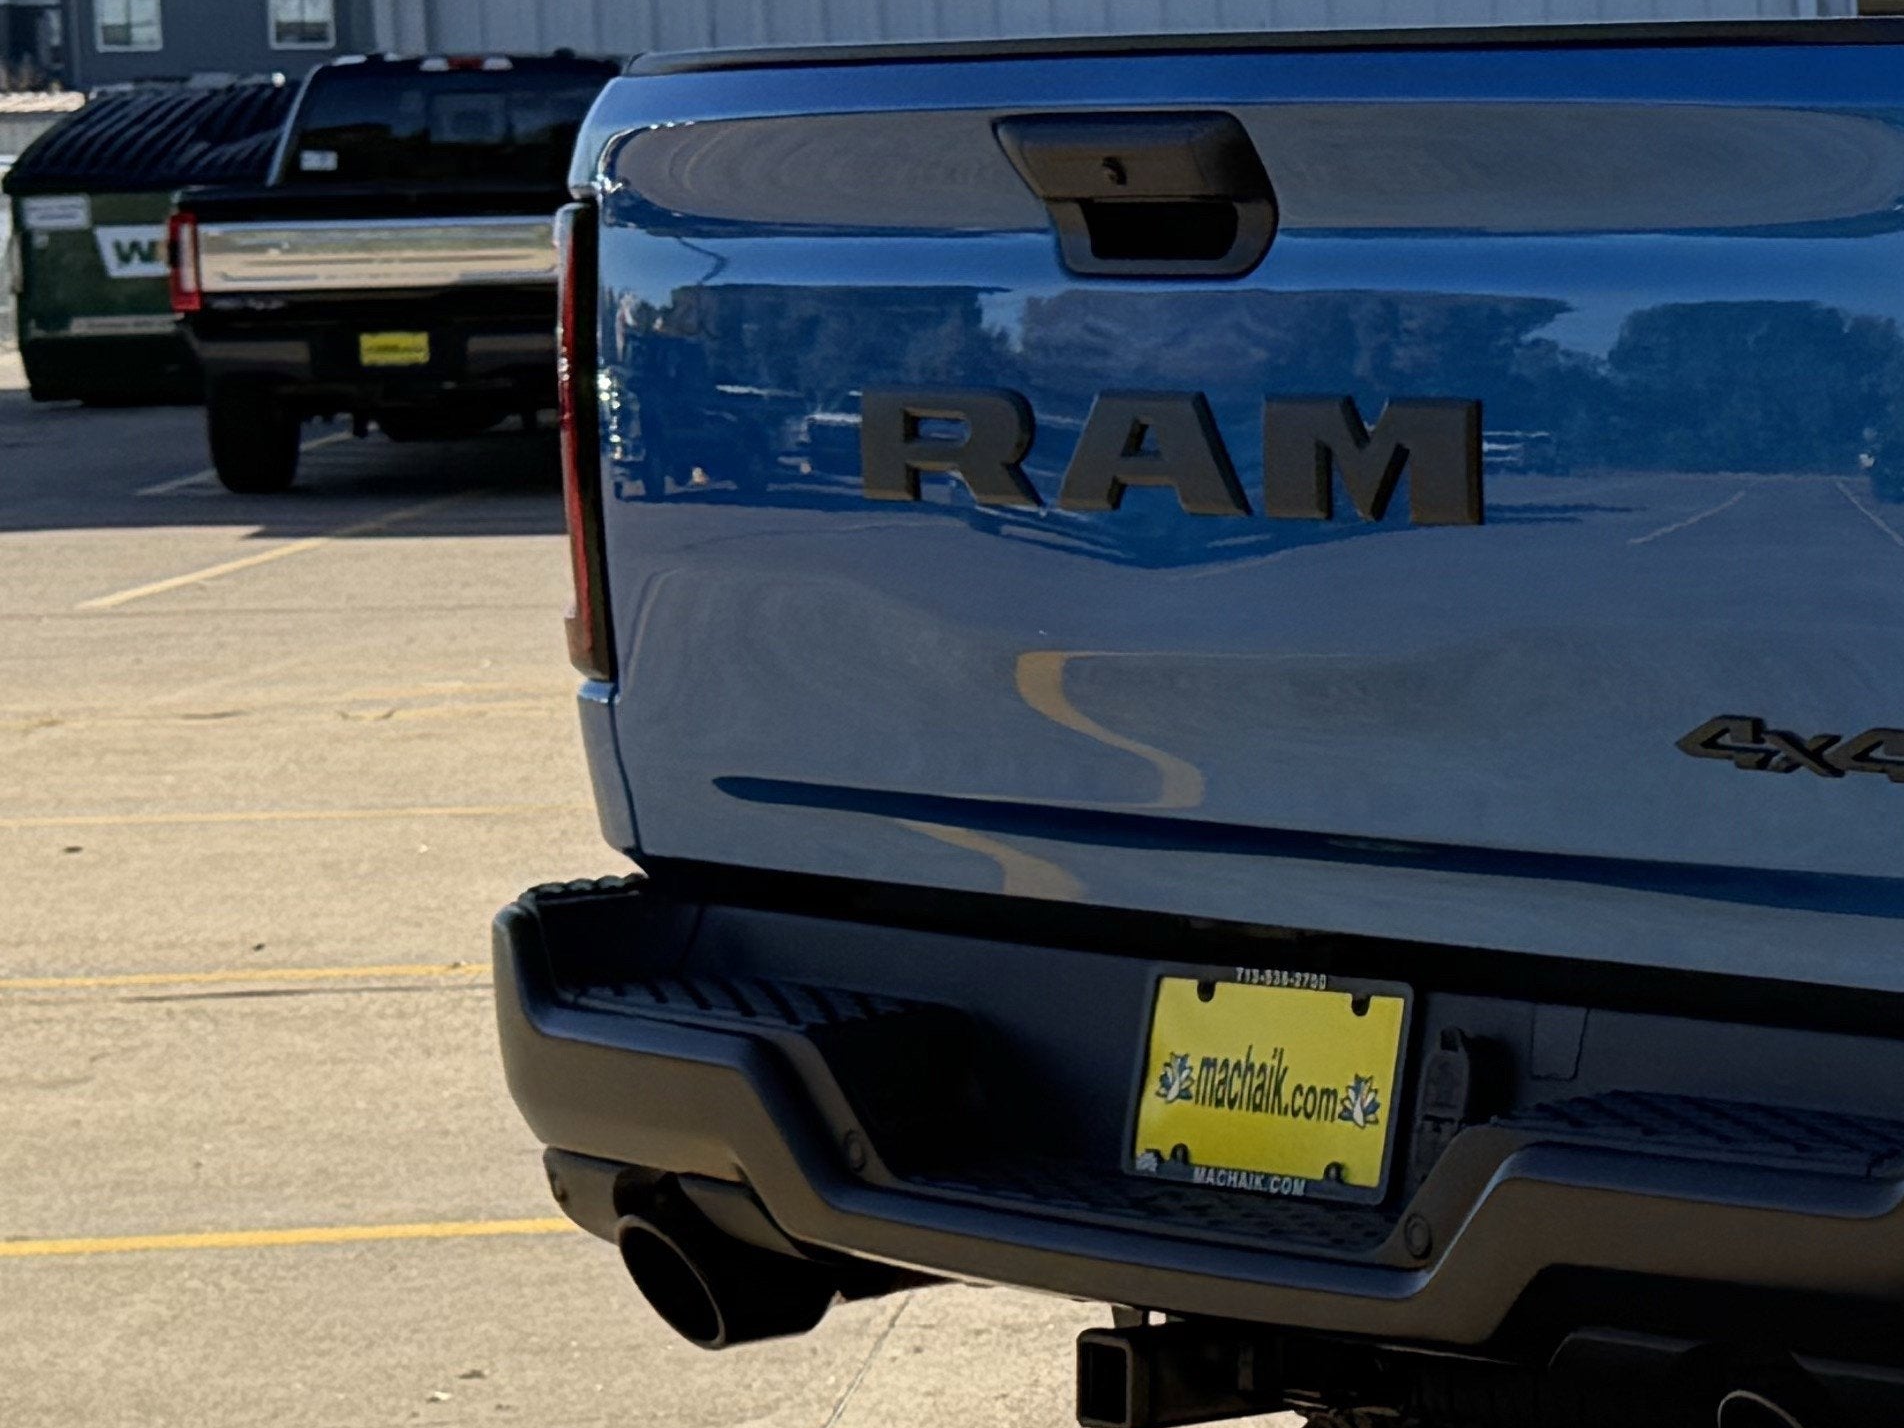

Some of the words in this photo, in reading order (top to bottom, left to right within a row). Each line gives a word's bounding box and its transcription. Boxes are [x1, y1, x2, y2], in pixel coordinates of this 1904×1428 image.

[861, 384, 1484, 525] RAM
[1194, 1044, 1339, 1122] machaik.com
[1193, 1166, 1306, 1196] MACHAIK.COM
